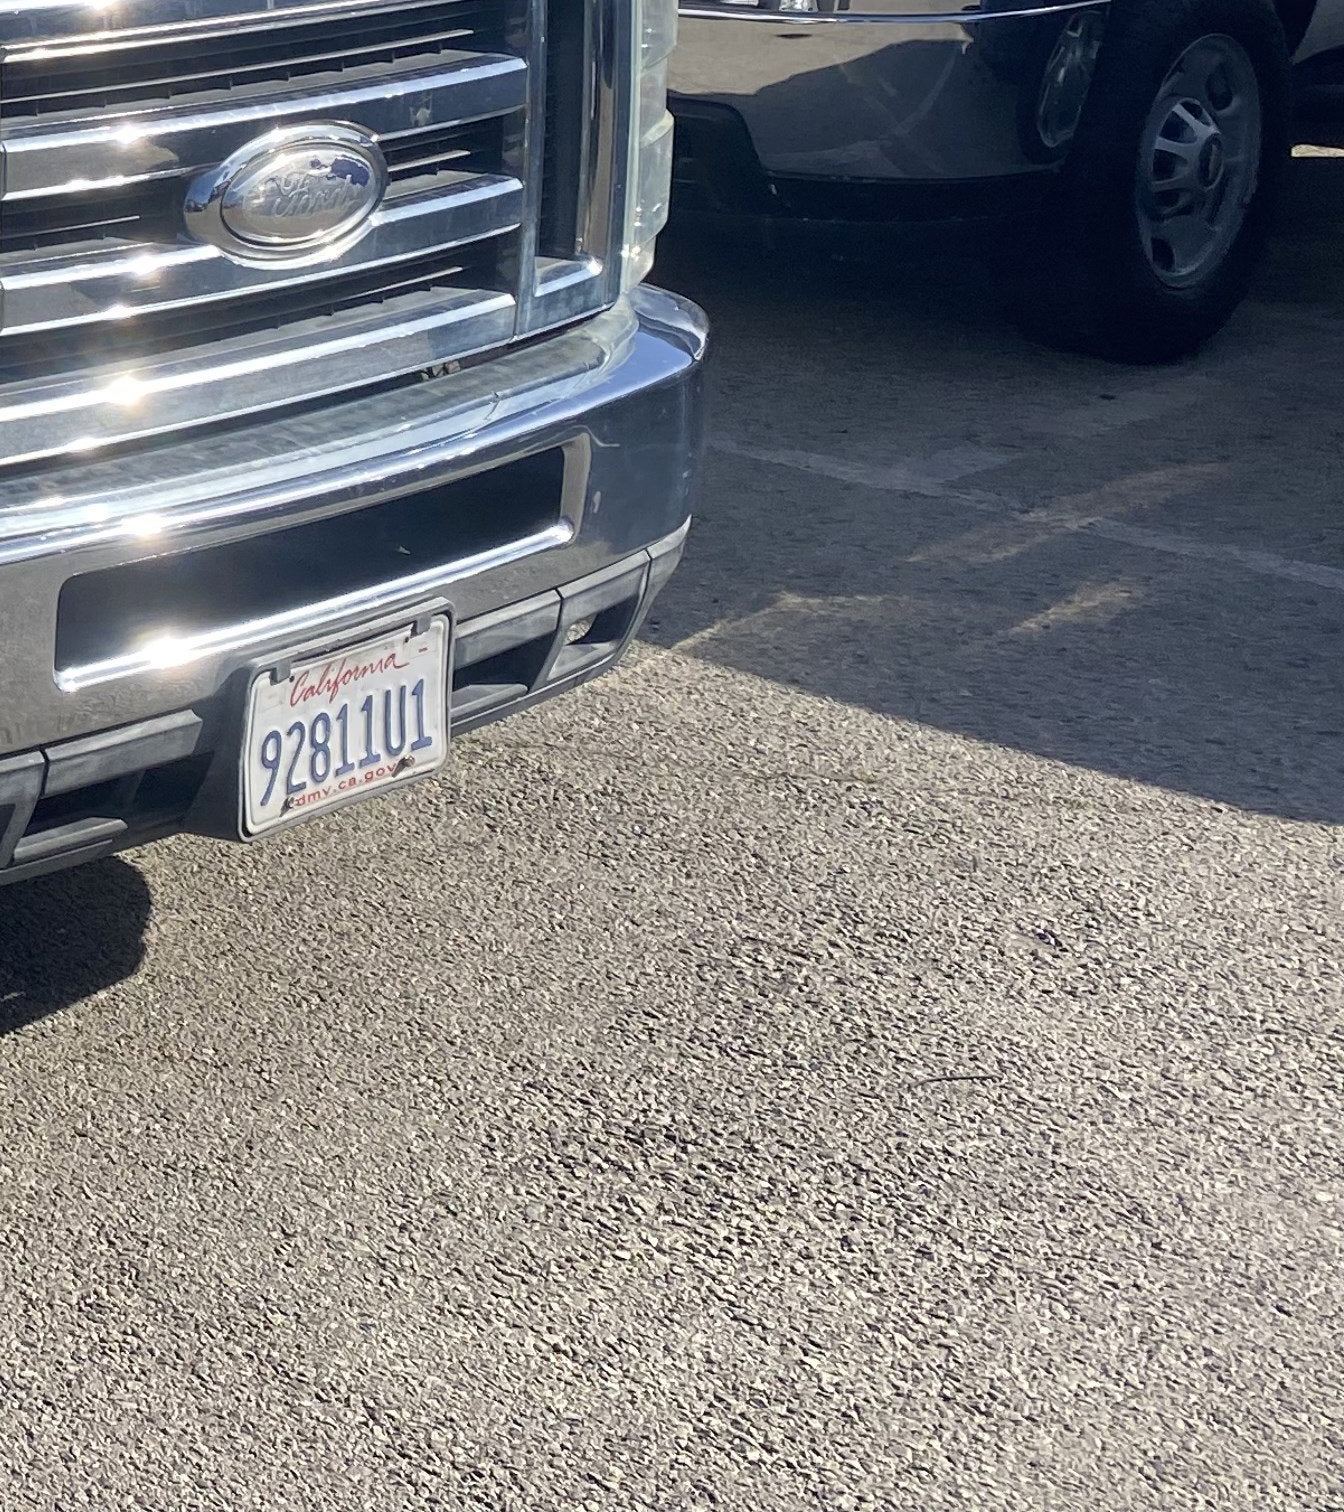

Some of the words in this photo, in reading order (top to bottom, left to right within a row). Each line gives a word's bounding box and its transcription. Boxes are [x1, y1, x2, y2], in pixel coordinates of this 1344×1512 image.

[289, 652, 410, 708] California
[259, 678, 433, 807] 92811U1
[294, 761, 397, 807] dmv.ca.gov
